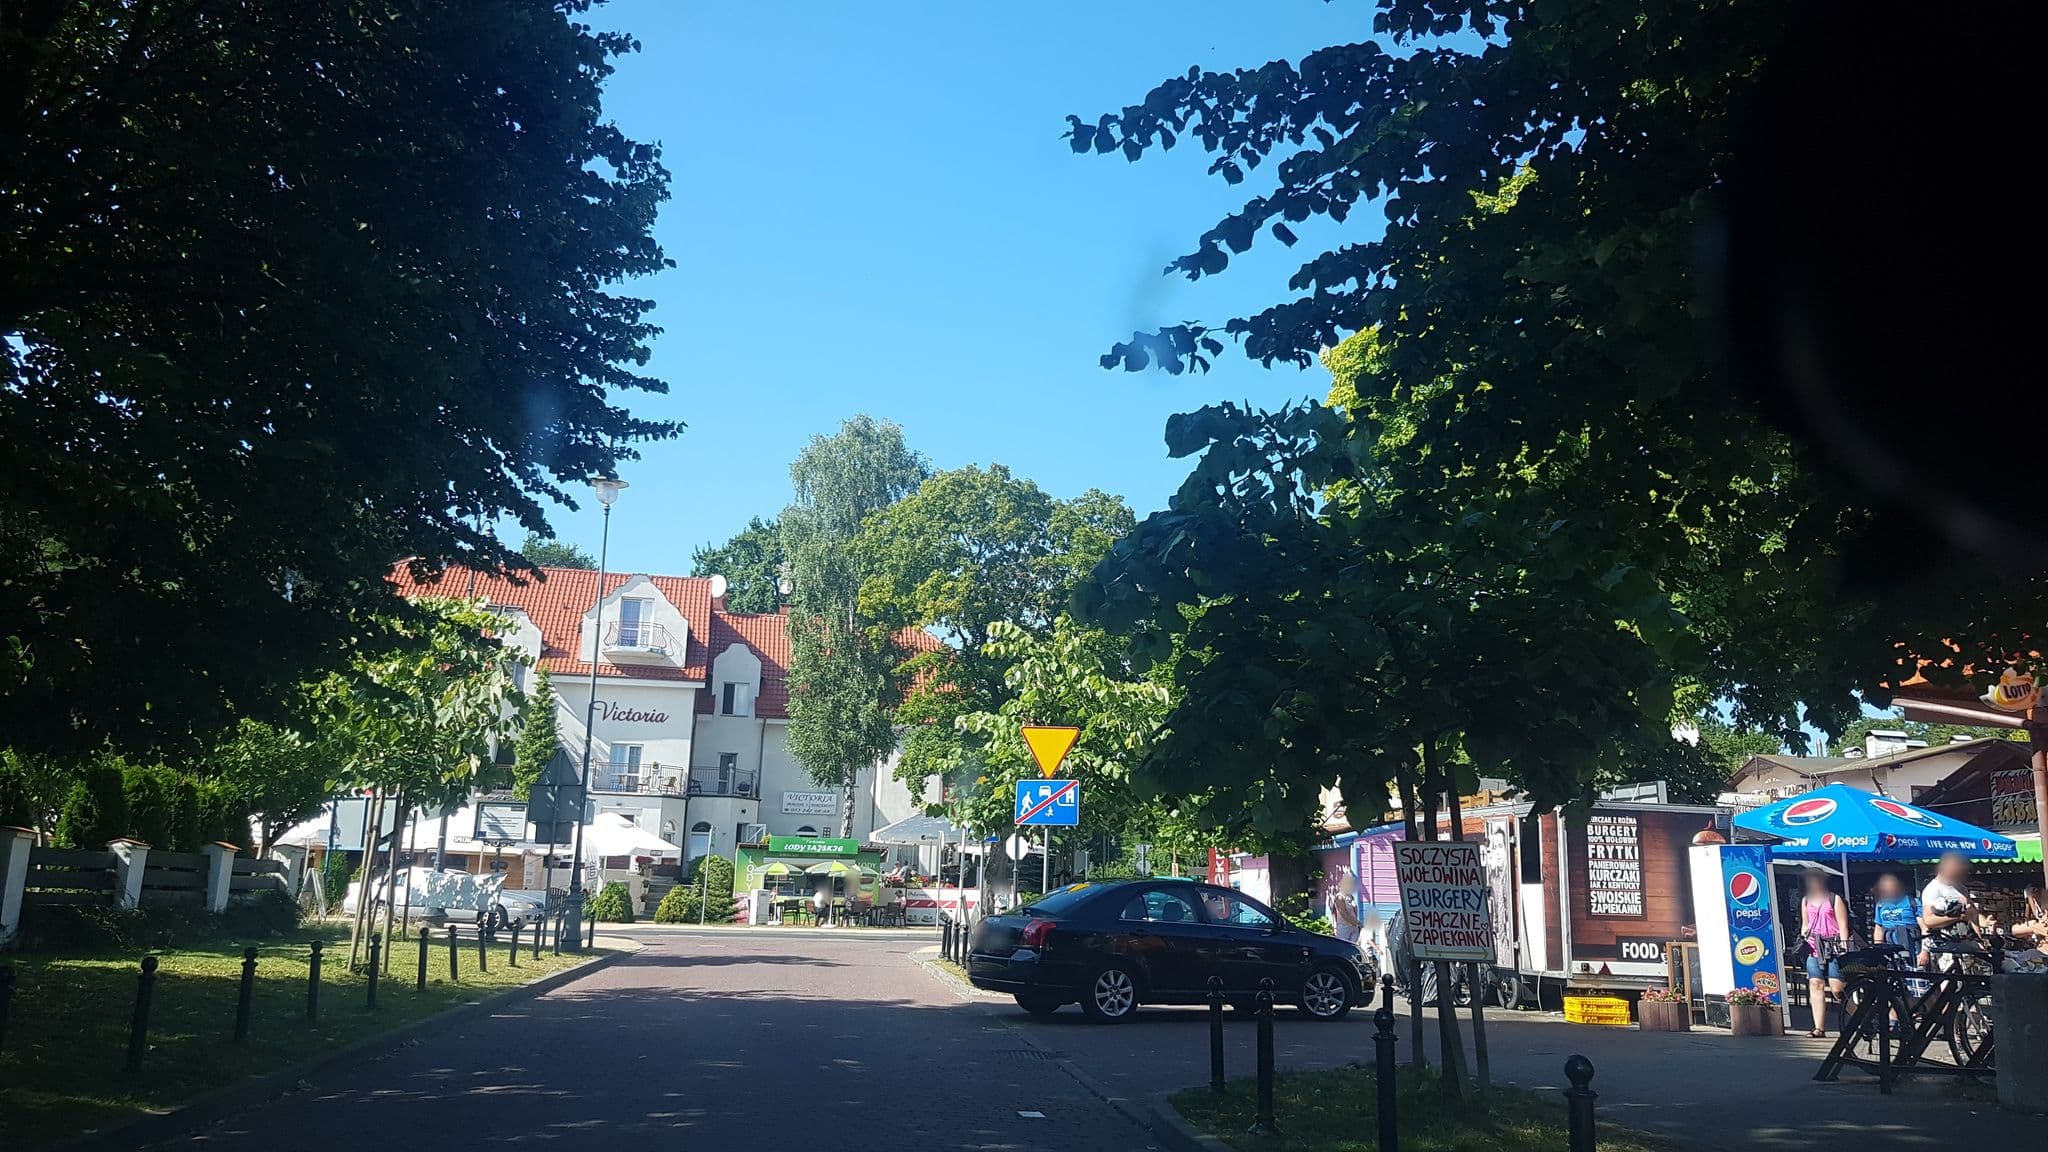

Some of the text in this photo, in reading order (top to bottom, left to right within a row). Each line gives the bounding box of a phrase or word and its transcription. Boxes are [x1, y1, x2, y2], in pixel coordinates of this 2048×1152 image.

[2003, 683, 2031, 698] LOTTO
[592, 700, 669, 723] Victoria
[788, 793, 833, 802] VICTORIA
[1587, 825, 1637, 837] BURGERY
[1837, 835, 1868, 848] pepsi
[1897, 837, 1919, 849] pepsi
[1927, 839, 1943, 849] LIVE
[1945, 840, 1958, 849] FOR
[1960, 840, 1976, 850] NOW
[1400, 847, 1478, 867] SOCZYSTA
[1588, 844, 1639, 860] FRYTKI
[1588, 860, 1640, 870] PANIEROWANE
[1401, 866, 1481, 887] WOŁOWINA
[1589, 869, 1640, 882] KURCZAKI
[1590, 881, 1601, 889] JAK
[1608, 881, 1640, 890] KENTUCKY
[1407, 888, 1484, 911] BURGERY
[1590, 890, 1641, 904] SWOJSKIE
[1591, 903, 1642, 914] ZAPIEKANKI
[1736, 908, 1761, 919] pepsi
[1409, 910, 1481, 930] SMACZNE
[1411, 928, 1490, 948] ZAPIEKANKI
[1622, 942, 1659, 959] FOOD
